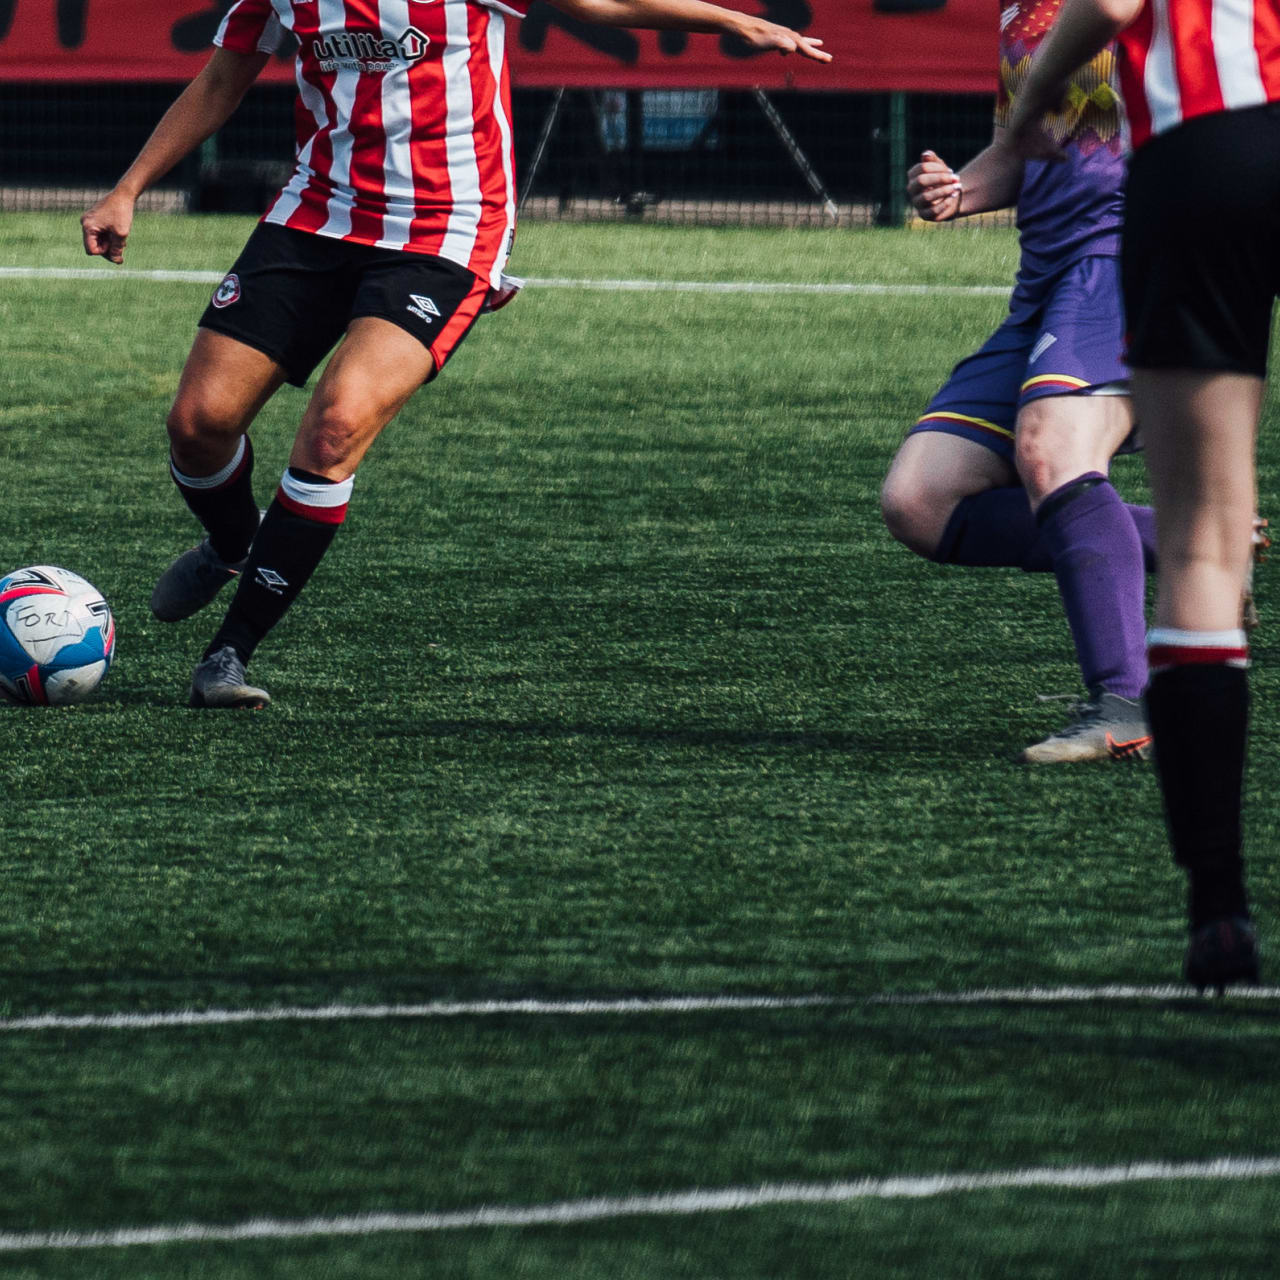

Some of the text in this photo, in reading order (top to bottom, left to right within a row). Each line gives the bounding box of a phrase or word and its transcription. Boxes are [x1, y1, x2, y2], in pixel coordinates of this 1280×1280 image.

[312, 31, 401, 60] utilita
[320, 60, 339, 72] life
[340, 60, 366, 72] with
